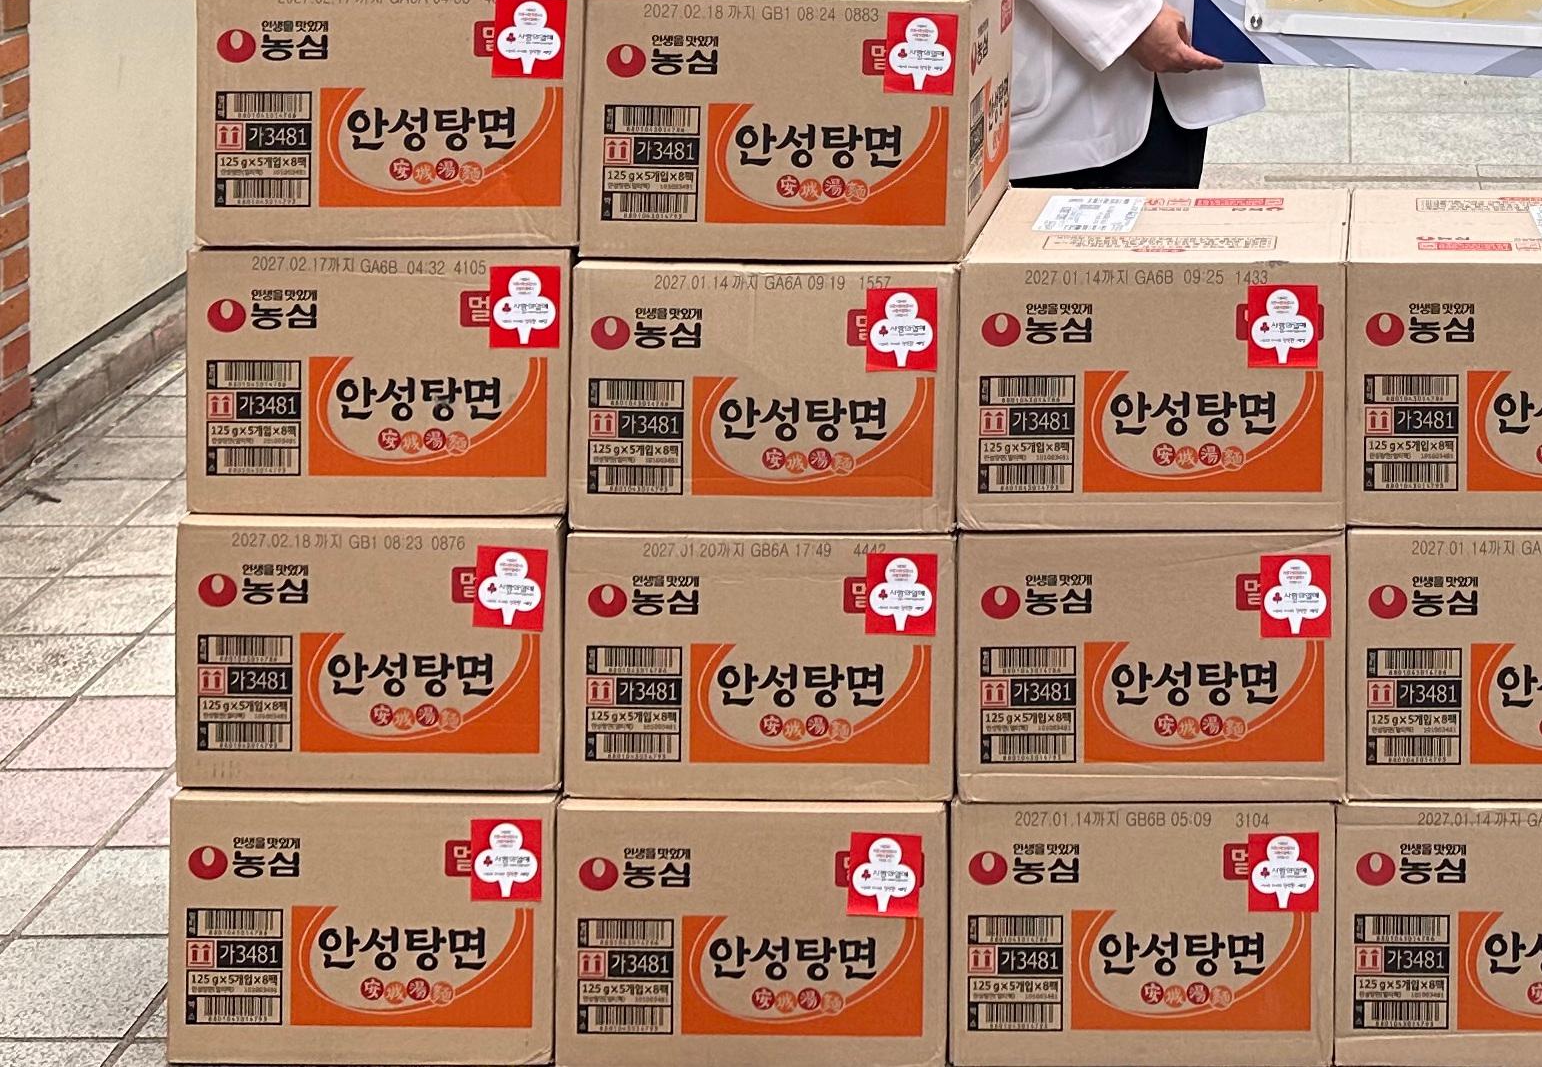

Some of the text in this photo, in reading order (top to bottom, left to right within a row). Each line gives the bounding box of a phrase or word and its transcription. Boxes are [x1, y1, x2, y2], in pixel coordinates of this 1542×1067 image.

[761, 6, 790, 20] GB1
[844, 7, 879, 21] 0883
[261, 33, 329, 59] 농심
[651, 47, 719, 74] 농심
[249, 127, 307, 147] 가3481
[346, 106, 517, 151] 안성탕면
[637, 141, 695, 161] 가3481
[733, 123, 903, 168] 안성탕면
[360, 258, 398, 274] GA6B
[454, 260, 486, 274] 4105
[1135, 270, 1174, 285] GA6B
[1236, 270, 1268, 285] 1433
[251, 302, 318, 328] 농심
[634, 322, 701, 348] 농심
[1025, 317, 1093, 343] 농심
[1409, 317, 1475, 342] 농심
[239, 396, 297, 415] 가3481
[335, 376, 502, 420] 안성탕면
[621, 415, 679, 435] 가3481
[718, 396, 888, 441] 안성탕면
[1012, 411, 1071, 432] 가3481
[1109, 391, 1277, 436] 안성탕면
[1397, 410, 1454, 430] 가3481
[349, 534, 376, 549] GB1
[431, 535, 465, 550] 0876
[242, 577, 309, 603] 농심
[632, 588, 699, 614] 농심
[1025, 588, 1092, 614] 농심
[1412, 590, 1479, 616] 농심
[231, 670, 288, 691] 가3481
[327, 652, 494, 696] 안성탕면
[716, 663, 885, 707] 안성탕면
[1110, 660, 1278, 706] 안성탕면
[619, 681, 678, 701] 가3481
[1014, 682, 1072, 702] 가3481
[1400, 684, 1457, 704] 가3481
[1126, 812, 1165, 826] GB6B
[1171, 812, 1212, 826] 05:09
[1236, 813, 1269, 828] 3104
[232, 851, 300, 877] 농심
[623, 861, 691, 887] 농심
[1012, 858, 1080, 884] 농심
[1400, 857, 1467, 883] 농심
[220, 944, 278, 964] 가3481
[317, 926, 487, 970] 안성탕면
[708, 936, 877, 980] 안성탕면
[1001, 951, 1059, 971] 가3481
[1098, 932, 1265, 975] 안성탕면
[1387, 950, 1445, 970] 가3481
[611, 954, 669, 974] 가3481
